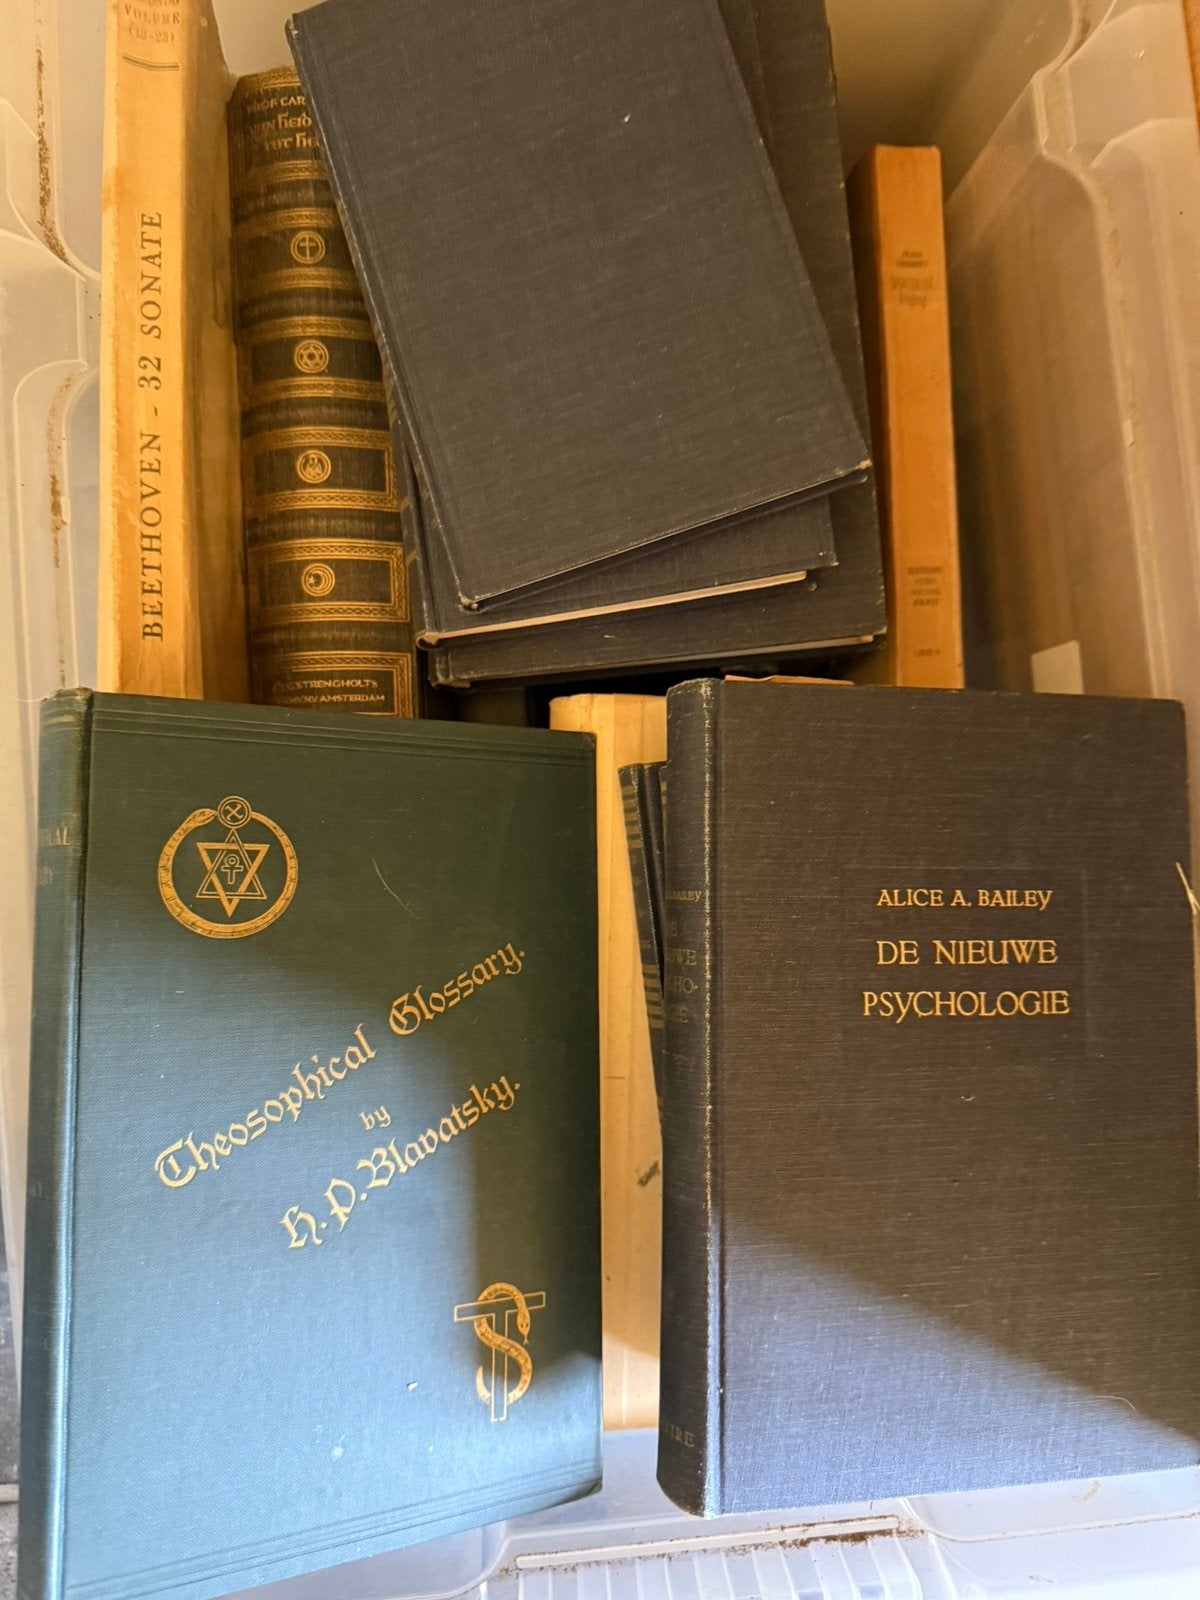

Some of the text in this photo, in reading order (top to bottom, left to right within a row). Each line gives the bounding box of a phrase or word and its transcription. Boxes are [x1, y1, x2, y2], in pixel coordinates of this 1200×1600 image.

[140, 212, 162, 340] SONATE
[137, 355, 162, 391] 32
[140, 431, 164, 642] BEETHOVEN
[319, 693, 386, 703] AMSTERDAM
[876, 889, 1053, 912] ALICE A. BAILEY
[876, 939, 1058, 965] DE NIEUWE
[863, 990, 1070, 1024] PSYCHOLOGIE
[154, 943, 526, 1189] Theosophical Glossary.
[356, 1075, 521, 1189] Blavatsky.
[359, 1105, 391, 1131] by
